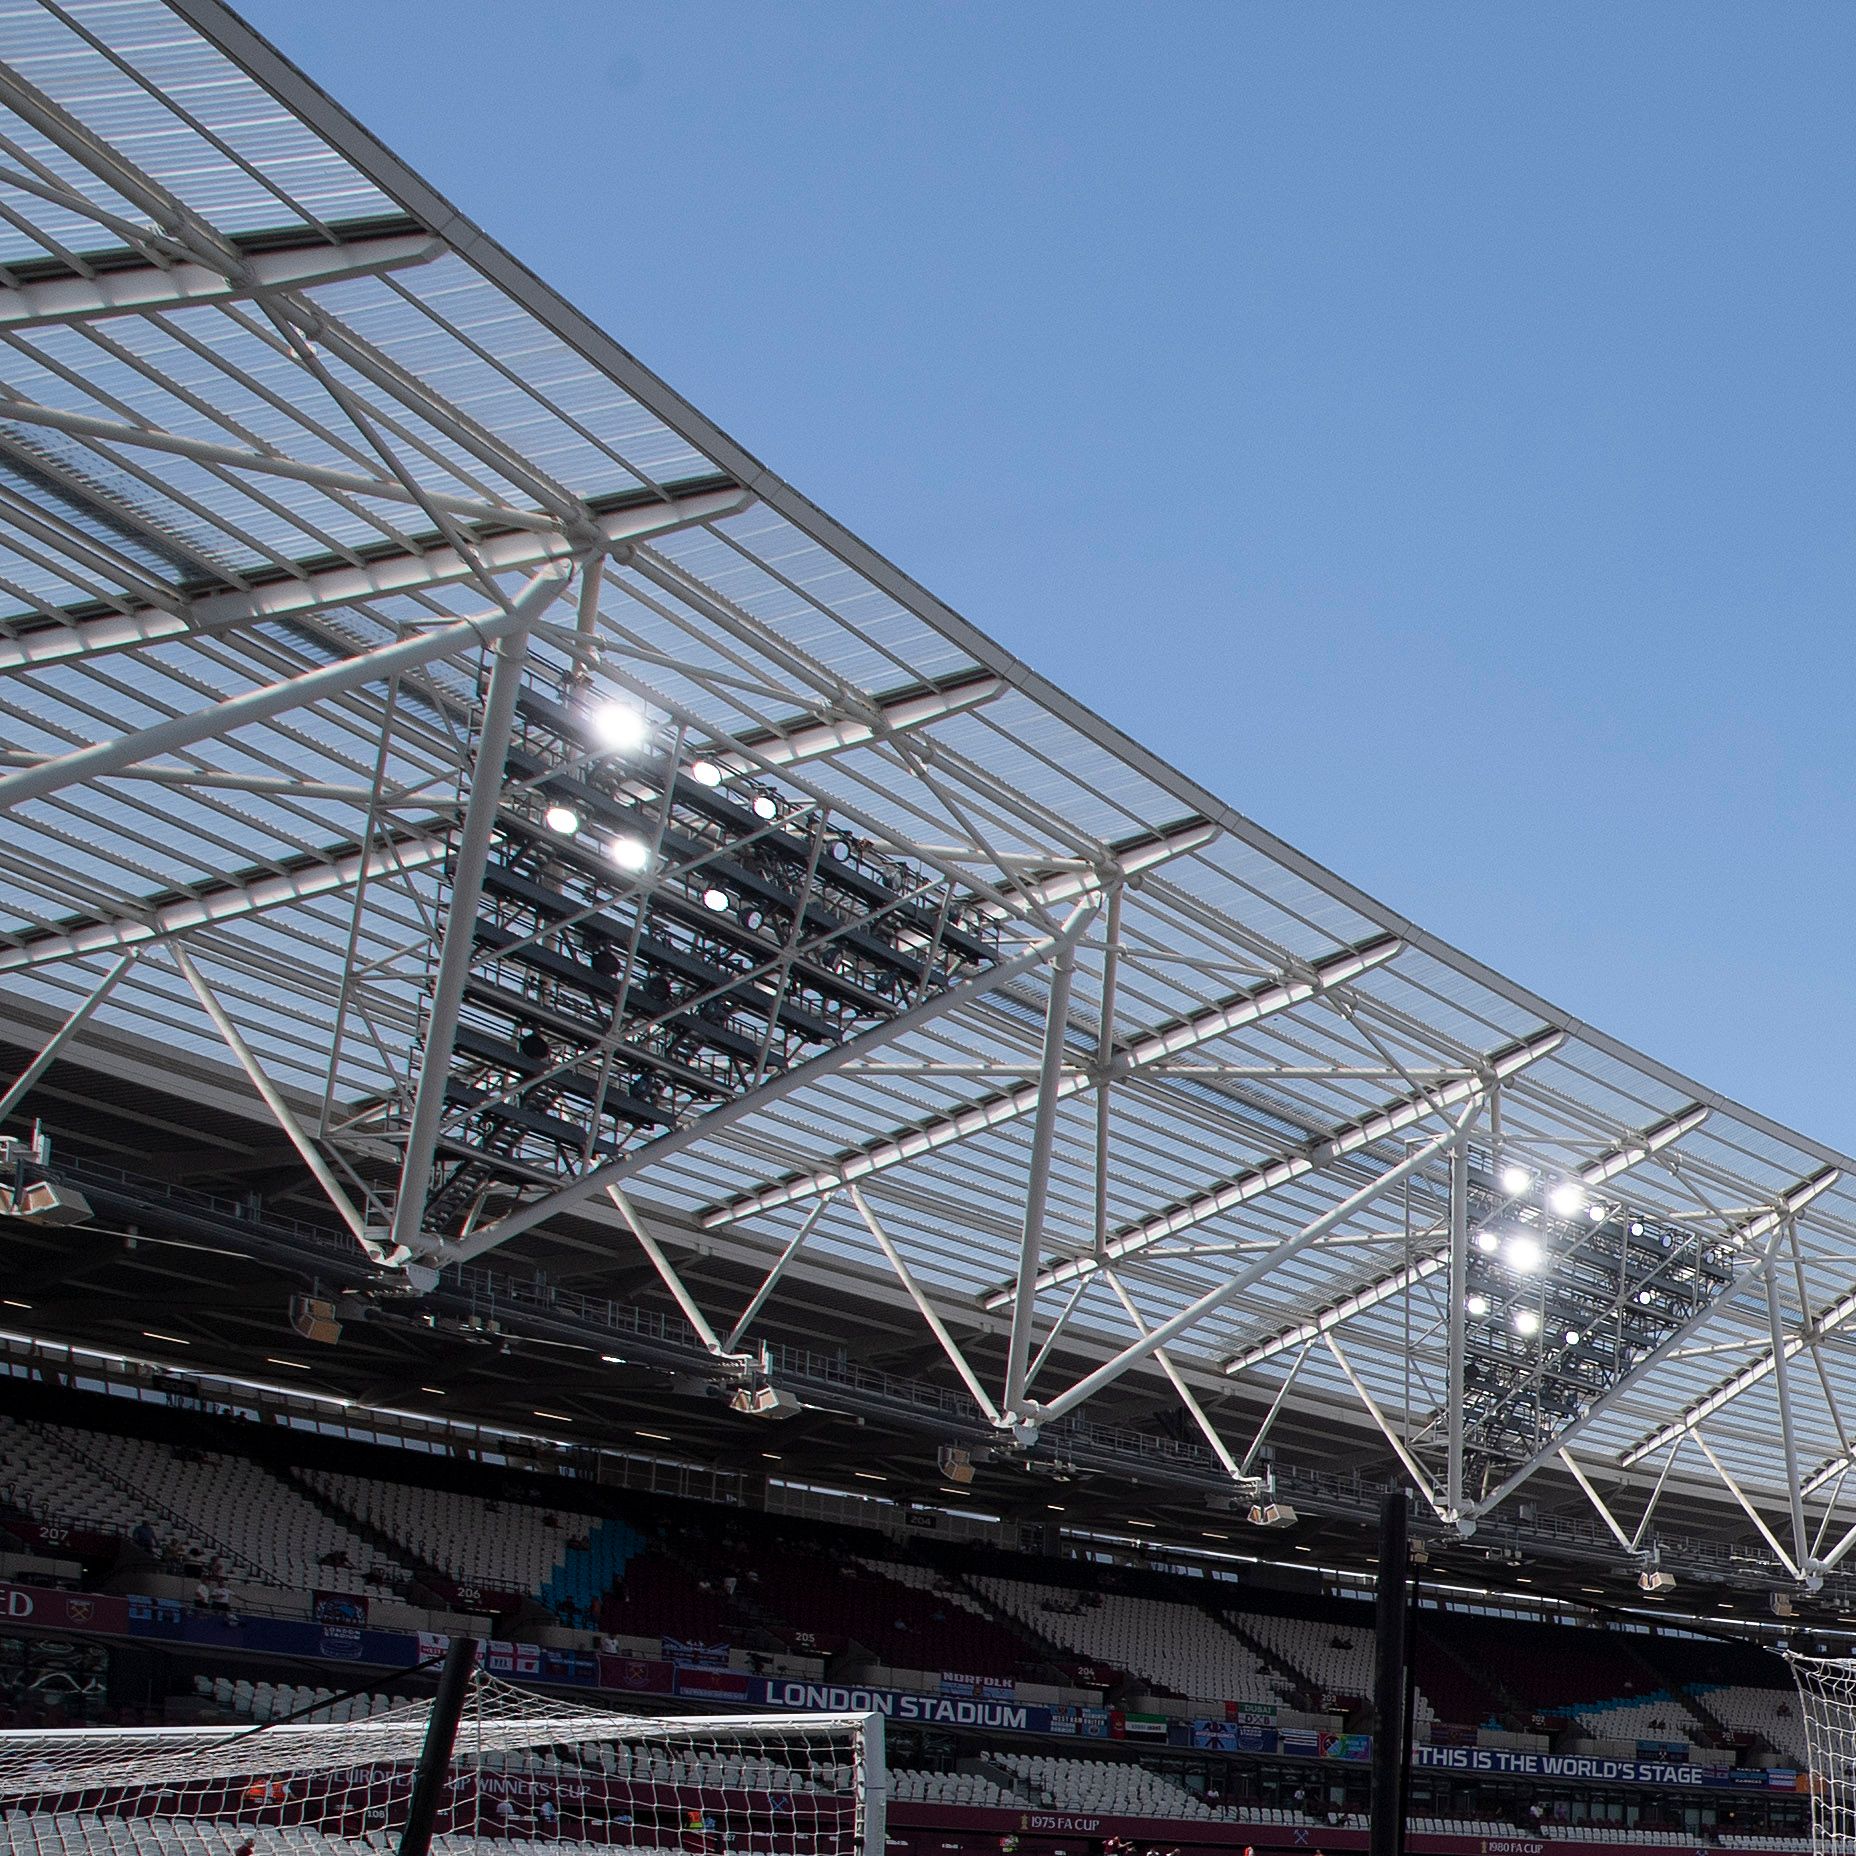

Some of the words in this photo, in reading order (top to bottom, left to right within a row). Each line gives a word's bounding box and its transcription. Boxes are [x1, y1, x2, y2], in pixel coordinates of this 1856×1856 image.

[39, 1527, 69, 1541] 207
[457, 1587, 482, 1600] 206
[795, 1632, 816, 1644] 205
[943, 1672, 1014, 1689] NORFOLK
[765, 1680, 893, 1718] LONDON
[900, 1695, 1028, 1730] STADIUM
[1418, 1745, 1468, 1768] THIS
[1472, 1750, 1493, 1769] IS
[1496, 1752, 1538, 1774] THE
[1542, 1756, 1636, 1780] WORLD'S
[1639, 1763, 1703, 1785] STAGE
[334, 1769, 418, 1787] EUROPEA
[558, 1783, 591, 1799] CUP
[1031, 1814, 1056, 1829] 1975
[1057, 1816, 1073, 1830] FA
[1074, 1818, 1101, 1832] CUP
[1488, 1841, 1510, 1853] 1980
[1511, 1843, 1523, 1853] FA
[1523, 1844, 1544, 1855] CUP
